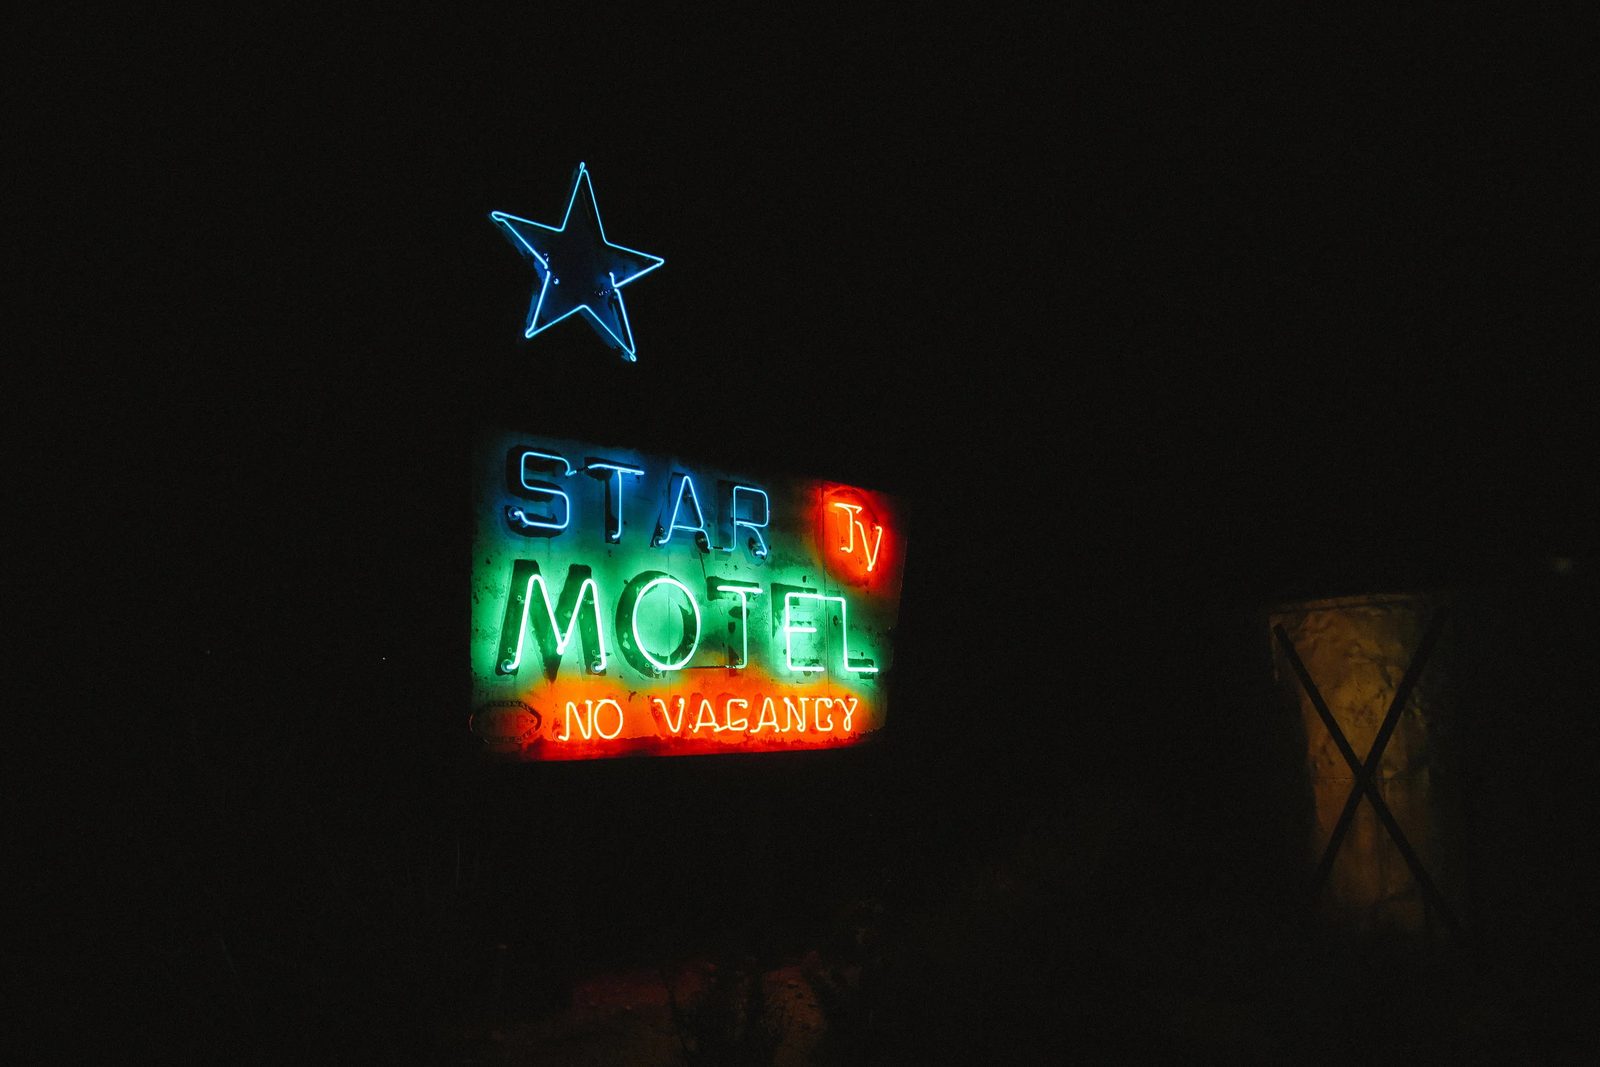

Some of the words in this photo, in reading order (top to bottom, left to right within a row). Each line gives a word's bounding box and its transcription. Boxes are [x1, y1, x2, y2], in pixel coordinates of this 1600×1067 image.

[507, 448, 771, 561] STAR
[833, 502, 883, 573] TV
[499, 566, 880, 674] MOTEL
[557, 698, 624, 742] NO
[652, 696, 859, 734] VACANCY
